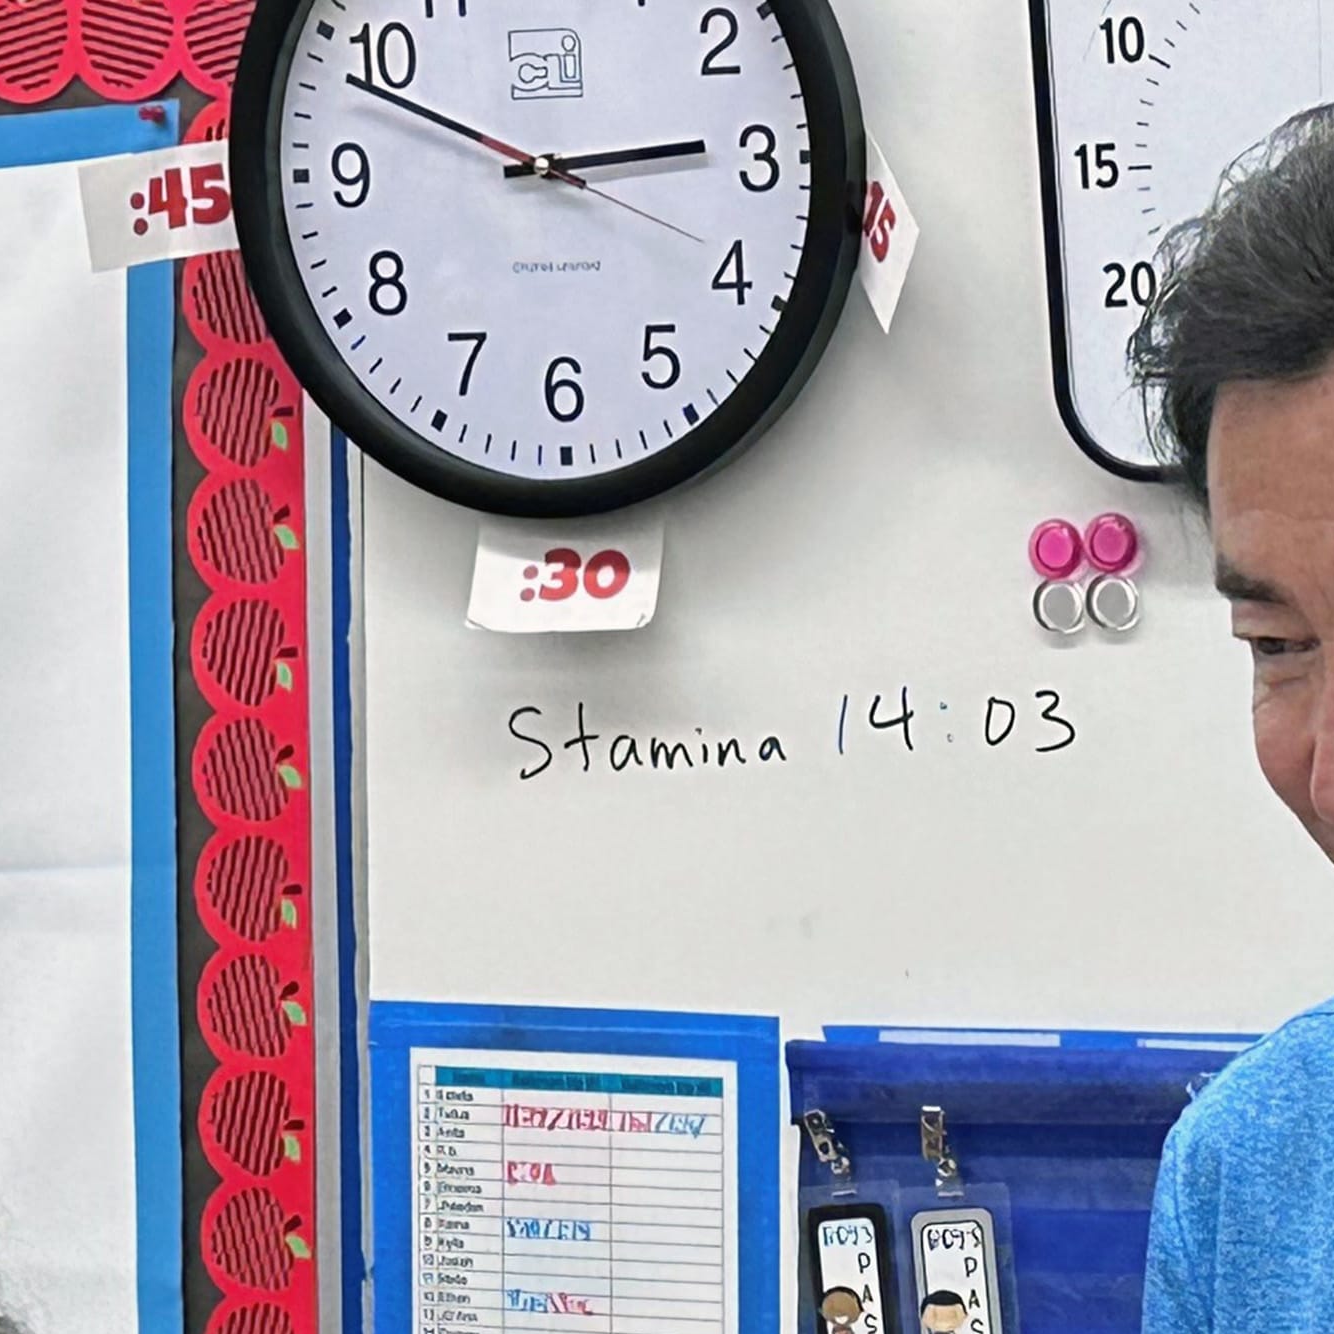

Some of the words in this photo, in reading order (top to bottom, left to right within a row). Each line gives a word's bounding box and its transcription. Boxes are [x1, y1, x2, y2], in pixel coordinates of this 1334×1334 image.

[349, 21, 417, 89] 10
[699, 12, 741, 76] 2
[1100, 17, 1145, 64] 10
[331, 142, 372, 207] 9
[739, 126, 780, 192] 3
[1074, 143, 1119, 189] 15
[130, 164, 232, 236] :45
[368, 250, 408, 316] 8
[712, 240, 753, 305] 4
[1102, 261, 1156, 308] 20
[446, 331, 488, 396] 7
[641, 324, 681, 389] 5
[543, 357, 585, 423] 6
[519, 547, 630, 602] :30
[508, 702, 787, 780] Stamina
